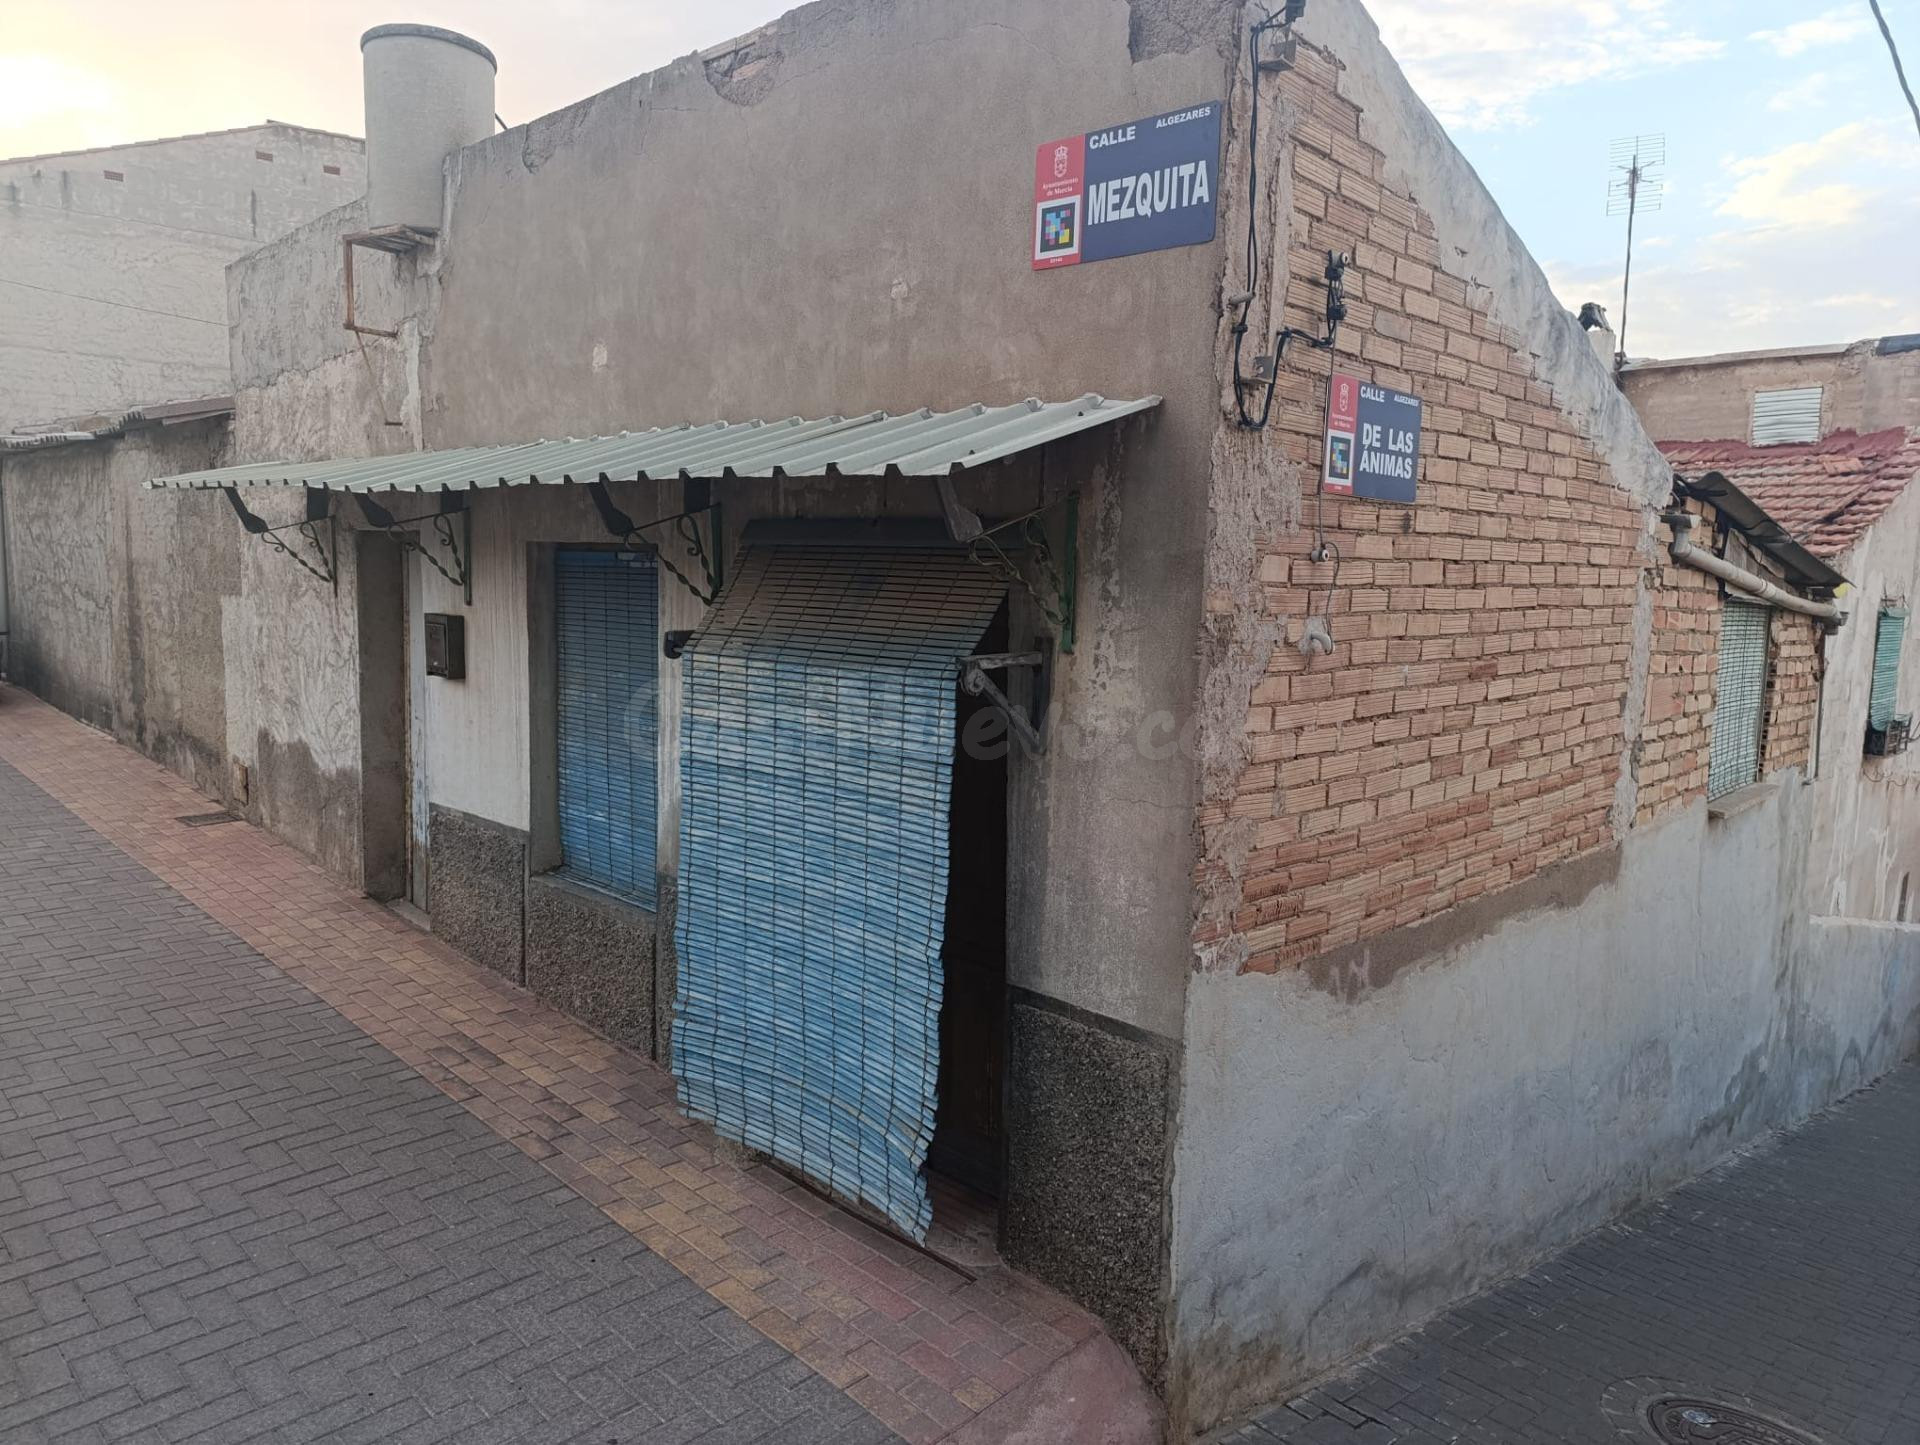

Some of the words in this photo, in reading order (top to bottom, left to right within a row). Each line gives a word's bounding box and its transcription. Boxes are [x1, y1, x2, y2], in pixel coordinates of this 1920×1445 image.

[1089, 126, 1136, 149] CALLE
[1156, 106, 1211, 128] ALGEZARES
[1088, 160, 1210, 226] MEZQUITA
[1360, 386, 1385, 402] CALLE
[1362, 423, 1381, 448] DE
[1388, 428, 1414, 454] LAS
[1360, 444, 1412, 479] ÁNIMAS
